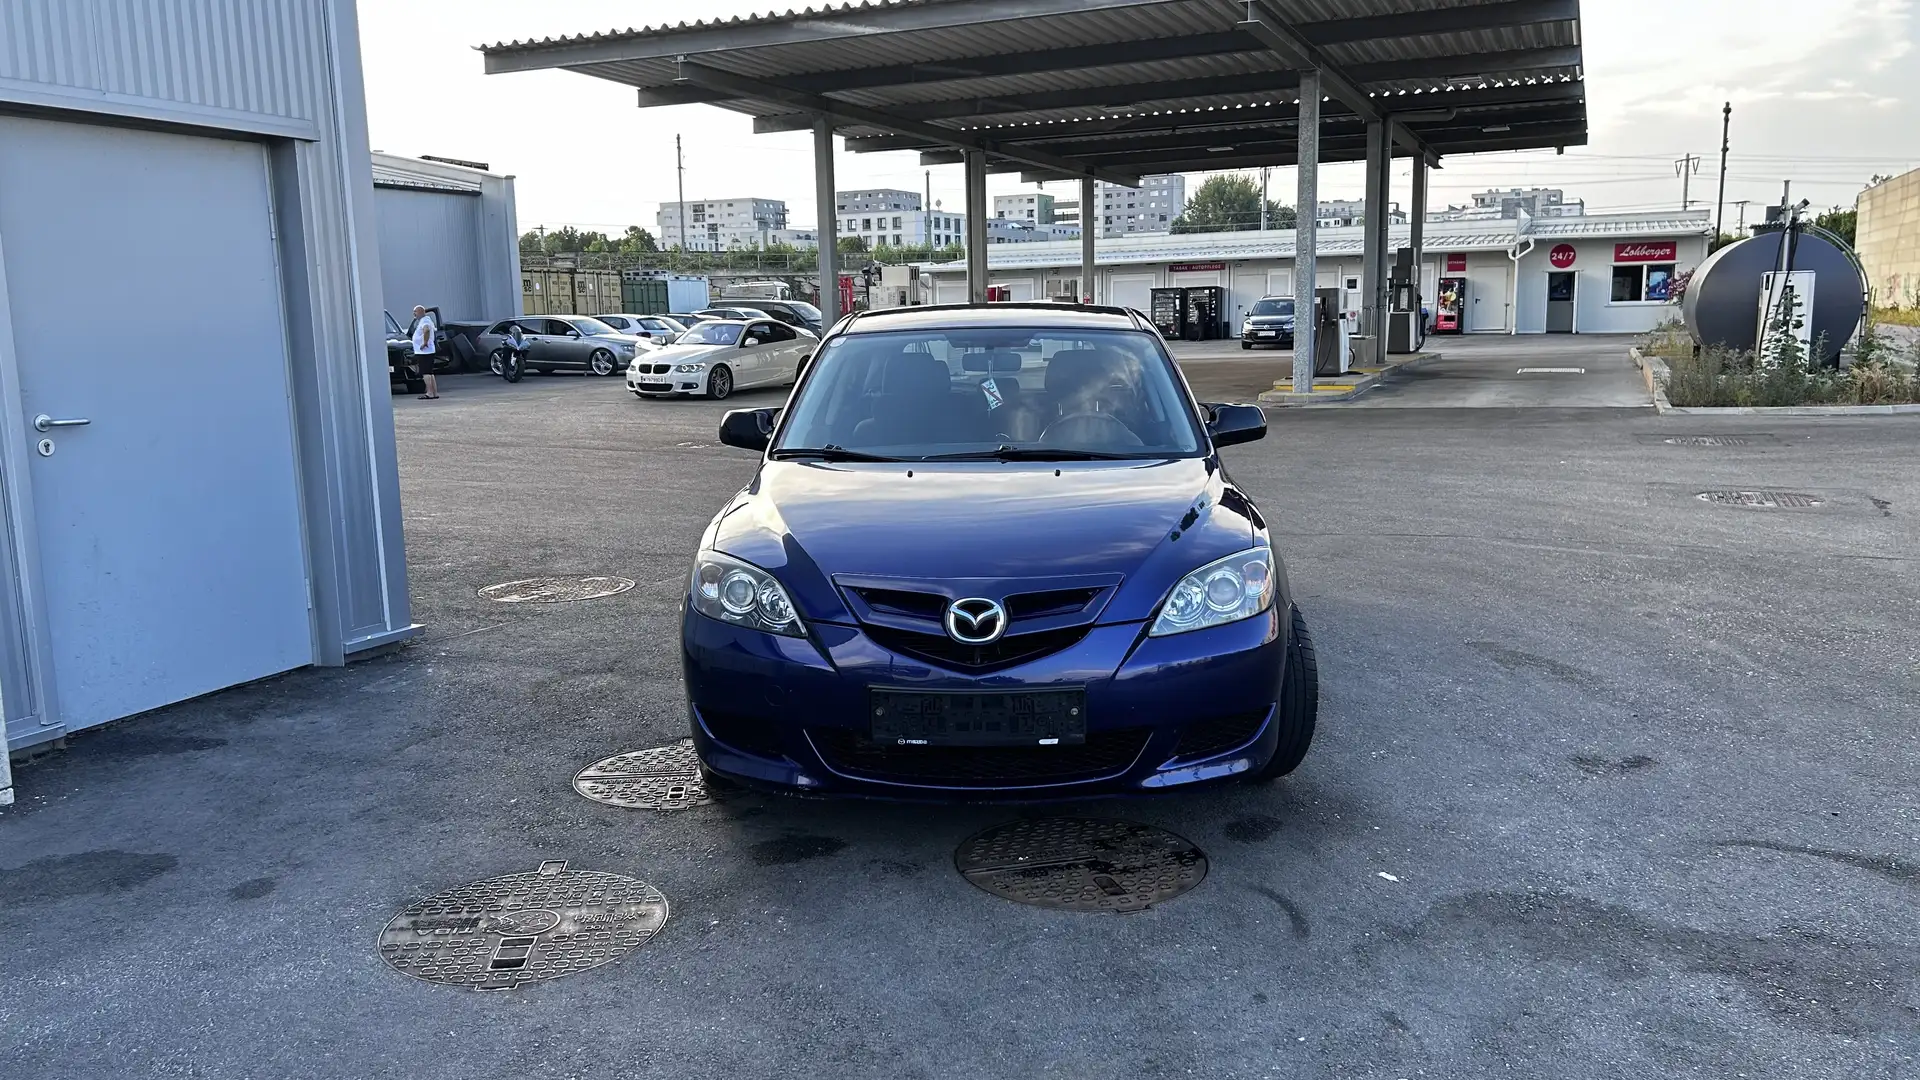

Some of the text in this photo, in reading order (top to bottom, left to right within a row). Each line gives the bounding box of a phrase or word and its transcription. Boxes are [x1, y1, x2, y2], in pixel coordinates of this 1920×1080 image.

[1551, 251, 1574, 261] 24/7
[1619, 245, 1671, 258] Lohberger
[416, 927, 474, 937] TIBA
